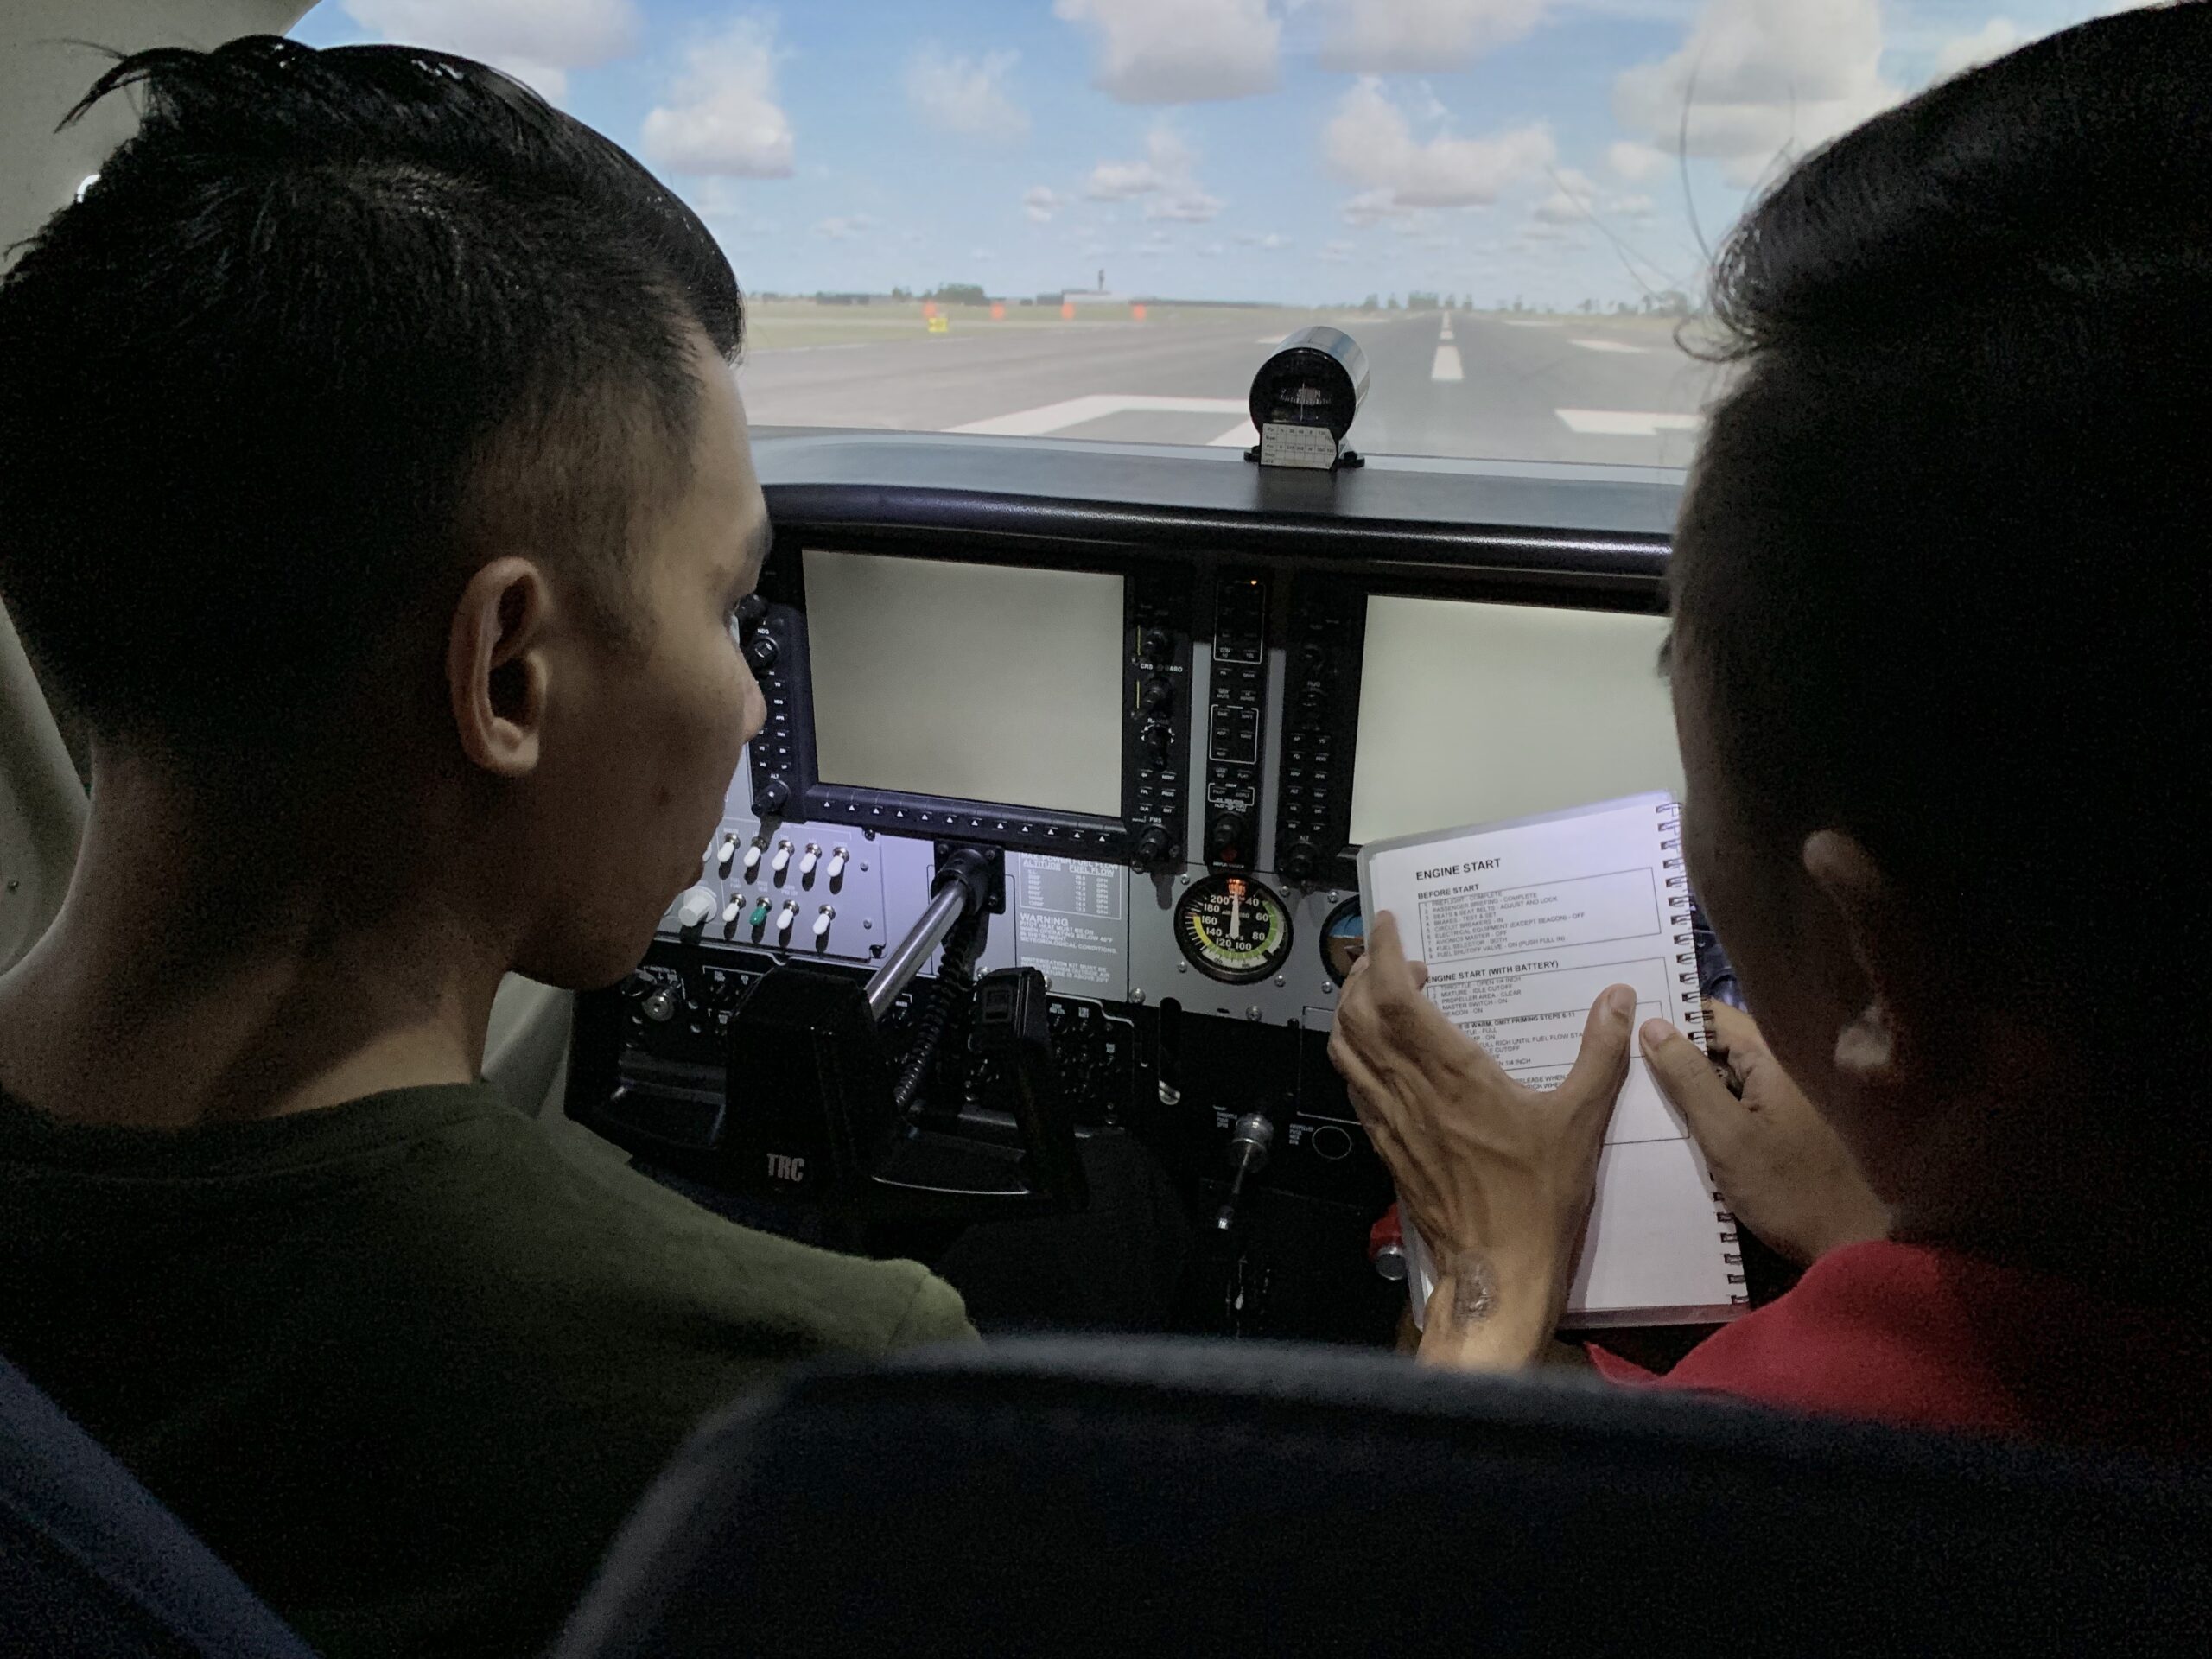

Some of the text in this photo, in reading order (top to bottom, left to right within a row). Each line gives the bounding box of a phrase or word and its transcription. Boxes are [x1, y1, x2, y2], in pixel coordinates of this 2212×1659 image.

[1042, 855, 1071, 864] POWER
[1023, 859, 1114, 876] ALTITUDE FUEL FLOW
[1416, 858, 1501, 881] ENGINE START
[1418, 884, 1479, 899] BEFORE START
[1469, 891, 1502, 900] COMPLETE
[1210, 895, 1229, 905] 200
[1245, 898, 1259, 906] 40
[1433, 892, 1537, 912] PASSENGER BRIEFING COMPLETE
[1204, 905, 1220, 913] 180
[1500, 901, 1524, 909] ADJUST
[1020, 912, 1068, 926] WARNING
[1202, 916, 1217, 925] 160
[1256, 913, 1269, 922] 60
[1434, 917, 1457, 926] BRAKES
[1434, 923, 1458, 932] CIRCUIT
[1460, 919, 1491, 928] BREAKERS
[1435, 928, 1470, 938] ELECTRICAL
[1473, 923, 1507, 933] EQUIPMENT
[1510, 918, 1536, 929] (EXCEPT
[1040, 928, 1074, 938] OPERATING
[1206, 927, 1222, 936] 140
[1028, 932, 1066, 941] INSTRUMENT
[1252, 932, 1265, 941] 80
[1436, 935, 1463, 944] AVIONICS
[1465, 932, 1490, 940] MASTER
[1020, 937, 1076, 948] METEOROLOGICAL
[1216, 938, 1232, 947] 120
[1236, 942, 1252, 950] 100
[1453, 939, 1484, 948] SELECTOR
[1454, 946, 1481, 955] SHUTOFF
[1519, 938, 1538, 947] (PUSH
[1426, 960, 1558, 983] ENGINE START (WITH BATTERY)
[1441, 981, 1471, 989] THROTTLE
[1441, 989, 1467, 997] MIXTURE
[1442, 994, 1477, 1003] PROPELLER
[1512, 1015, 1538, 1023] PRIMING
[1495, 1045, 1520, 1053] CUTOFF
[767, 1153, 805, 1182] TRC
